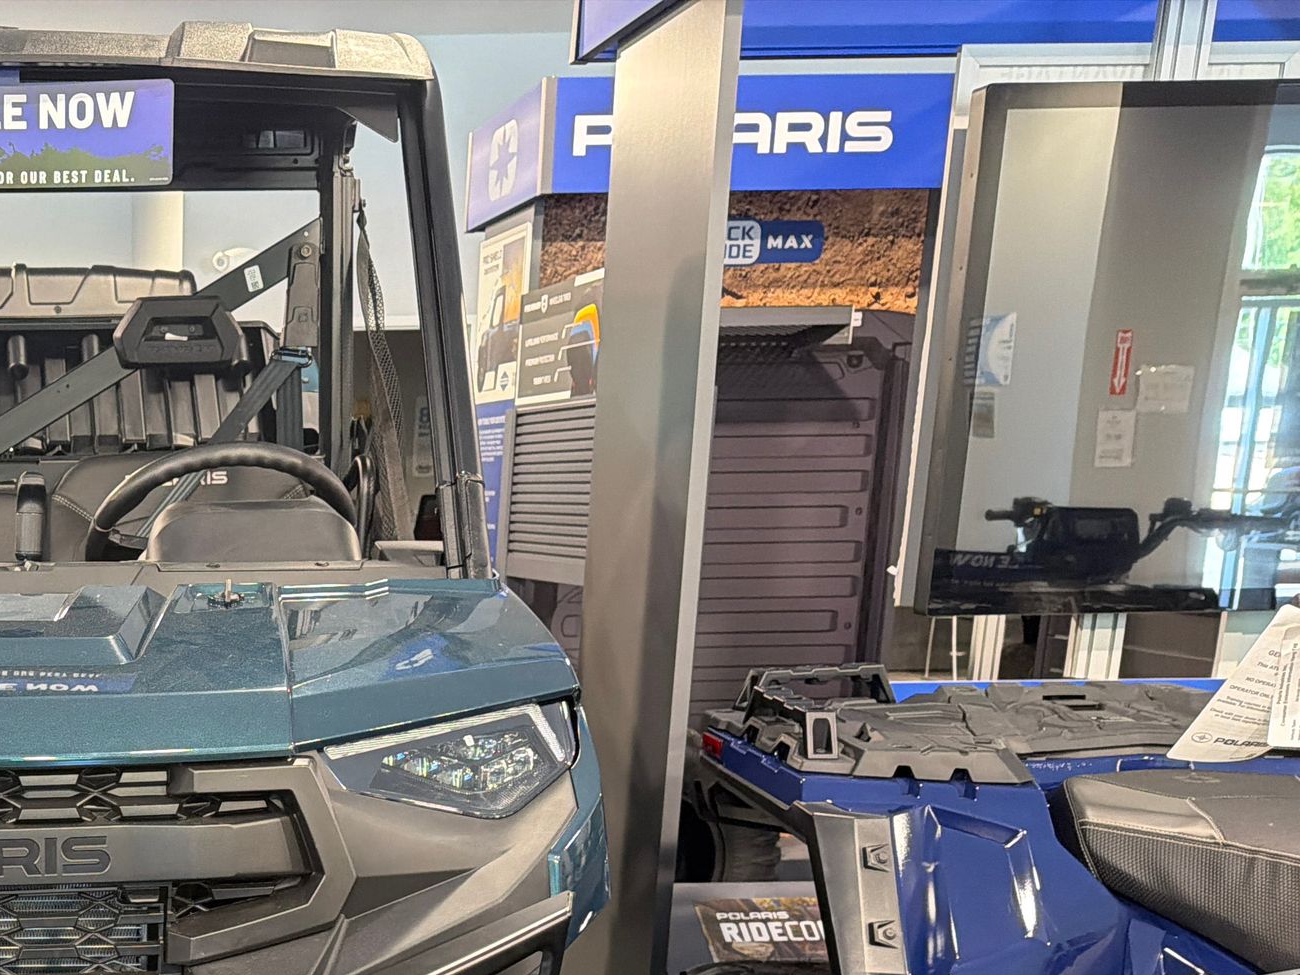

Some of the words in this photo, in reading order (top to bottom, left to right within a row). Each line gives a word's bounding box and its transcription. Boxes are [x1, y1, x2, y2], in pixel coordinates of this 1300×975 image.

[38, 91, 135, 130] NOW
[572, 111, 894, 156] PARIS
[20, 170, 47, 184] OUR
[53, 170, 88, 184] BEST
[94, 169, 135, 183] DEAL.
[767, 234, 813, 249] MAX
[716, 911, 789, 920] POLARIS
